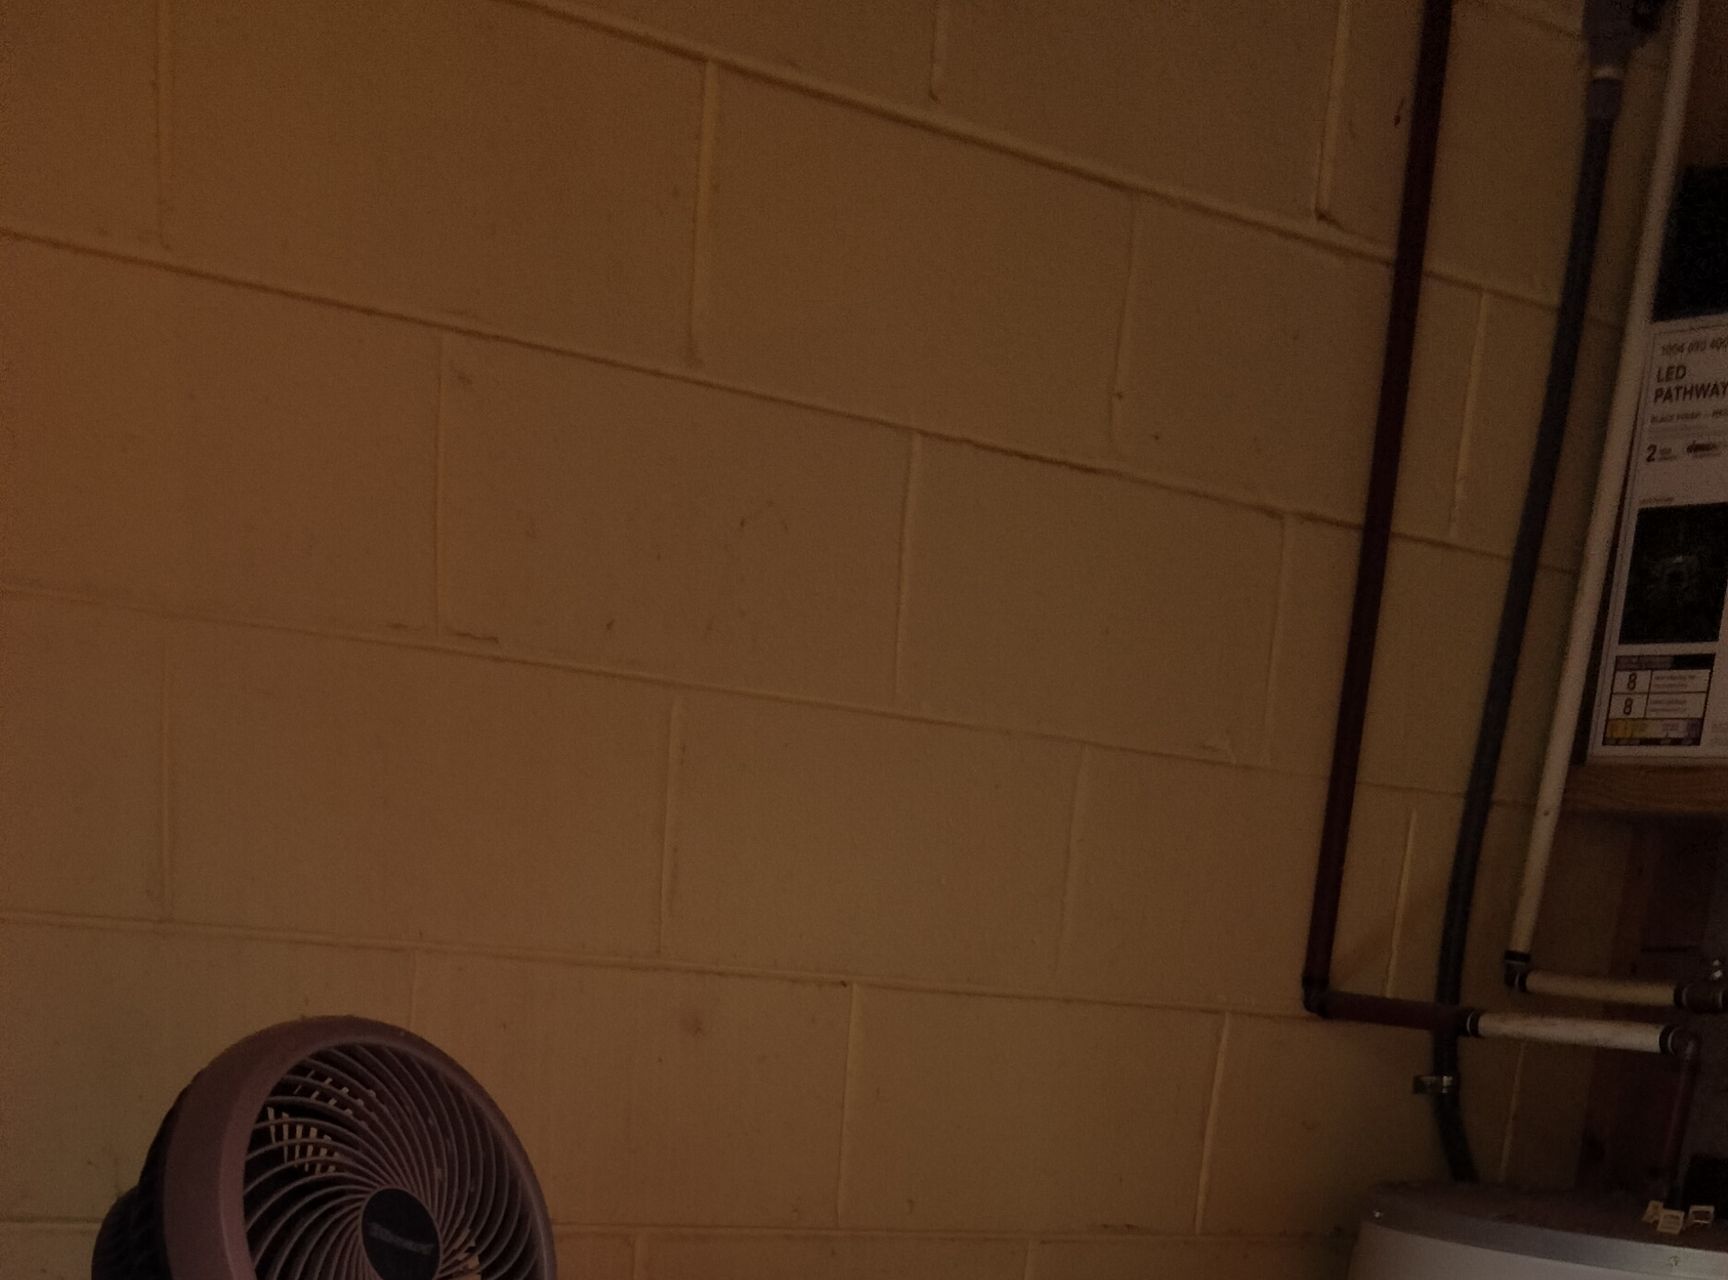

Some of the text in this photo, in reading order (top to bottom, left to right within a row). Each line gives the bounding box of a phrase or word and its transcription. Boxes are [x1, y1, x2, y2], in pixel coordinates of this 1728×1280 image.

[1656, 365, 1687, 383] LED
[1646, 444, 1657, 463] 2
[1627, 672, 1638, 690] 8
[1623, 697, 1634, 715] 8
